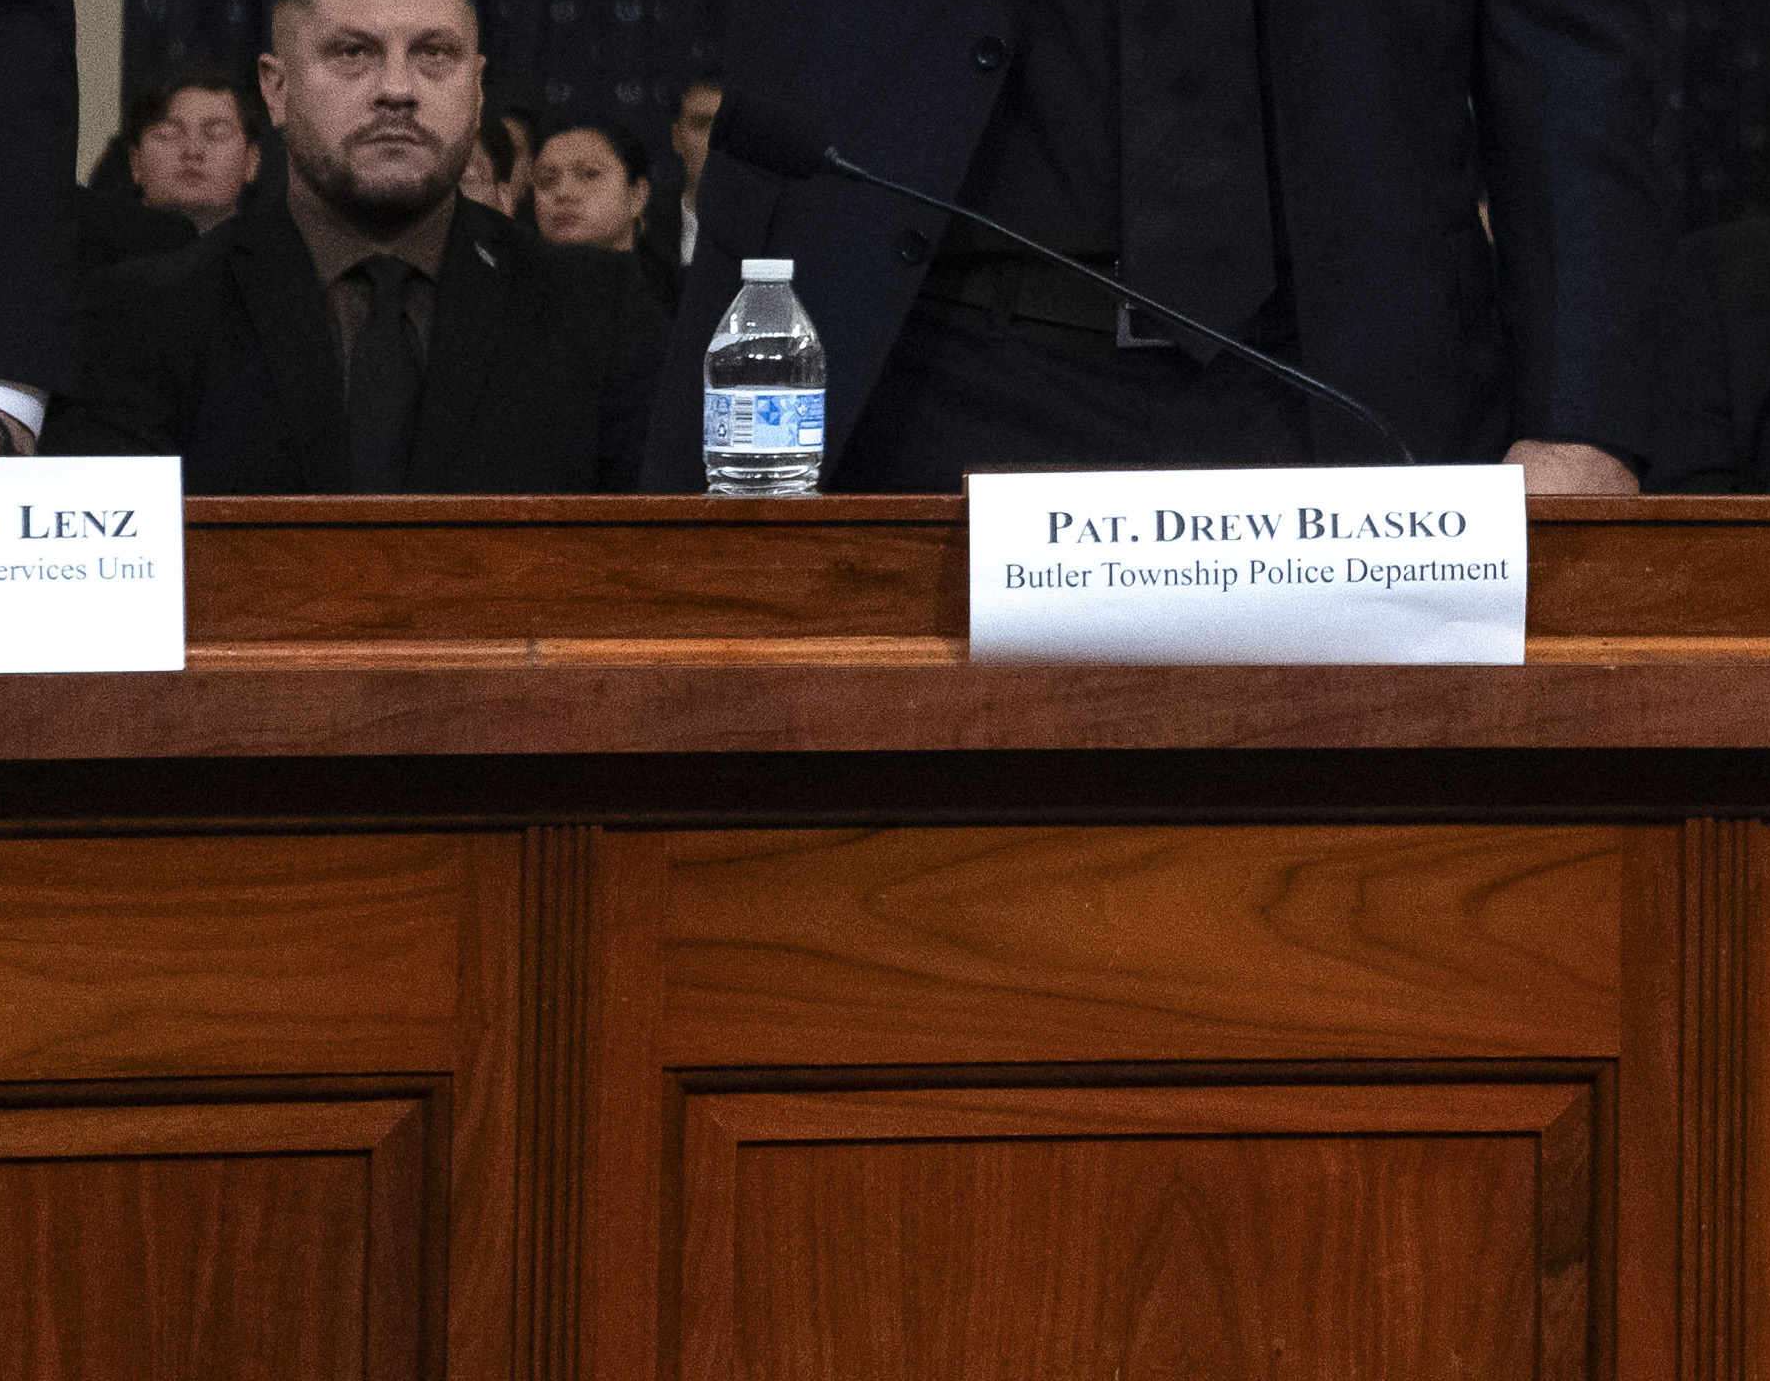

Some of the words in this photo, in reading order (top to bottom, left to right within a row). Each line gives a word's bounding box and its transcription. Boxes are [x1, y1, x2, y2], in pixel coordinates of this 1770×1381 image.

[19, 504, 139, 541] LENZ
[1046, 510, 1140, 544] PAT.
[1154, 508, 1282, 543] DREW
[1296, 506, 1467, 540] BLASKO
[98, 556, 155, 581] Unit
[1005, 562, 1092, 590] Butler
[1101, 559, 1239, 593] Township
[1249, 557, 1335, 586] Police
[1346, 557, 1509, 590] Department
